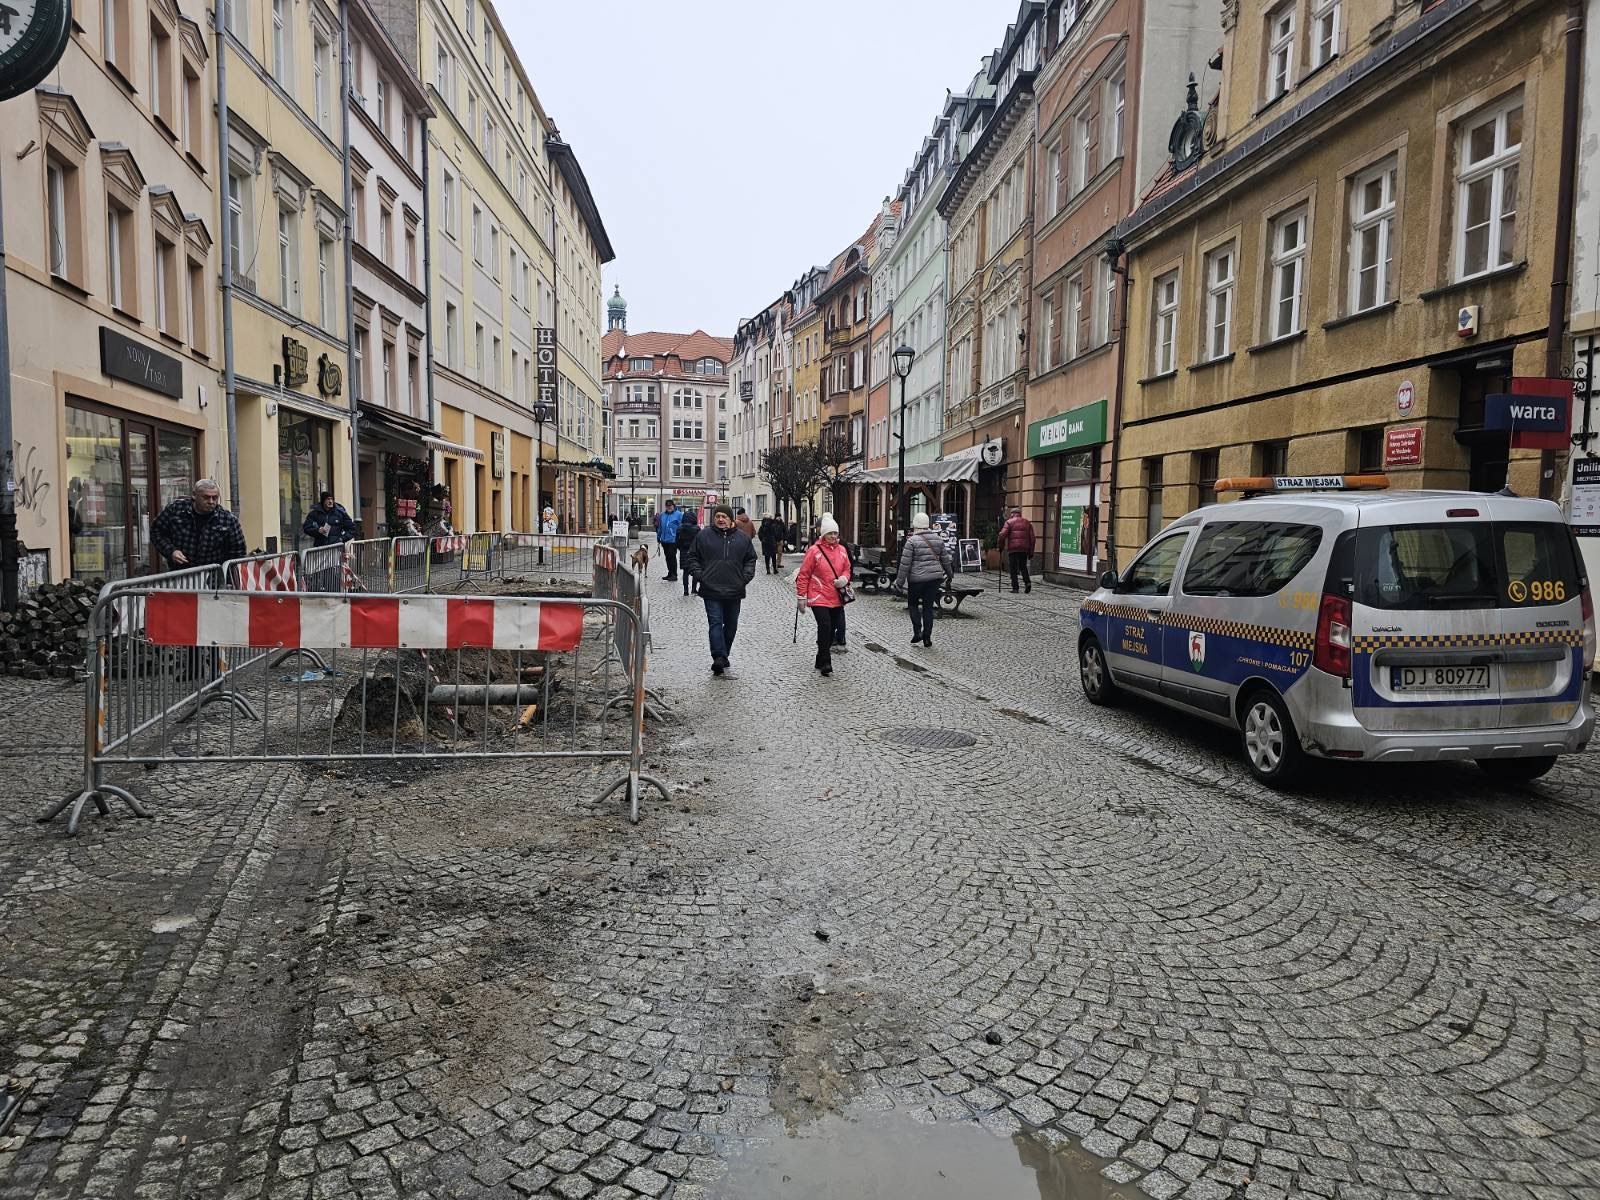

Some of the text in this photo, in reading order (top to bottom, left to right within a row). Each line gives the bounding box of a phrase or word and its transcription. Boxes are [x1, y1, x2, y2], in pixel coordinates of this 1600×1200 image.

[287, 338, 308, 361] Salon
[1510, 404, 1556, 420] warta
[1041, 420, 1084, 441] VELO BANK
[1305, 478, 1341, 487] MIEJSKA
[1531, 581, 1565, 600] 986
[1122, 639, 1149, 655] MIEJSKA
[1290, 651, 1310, 668] 107
[1405, 669, 1427, 685] DJ
[1435, 668, 1486, 685] 80977
